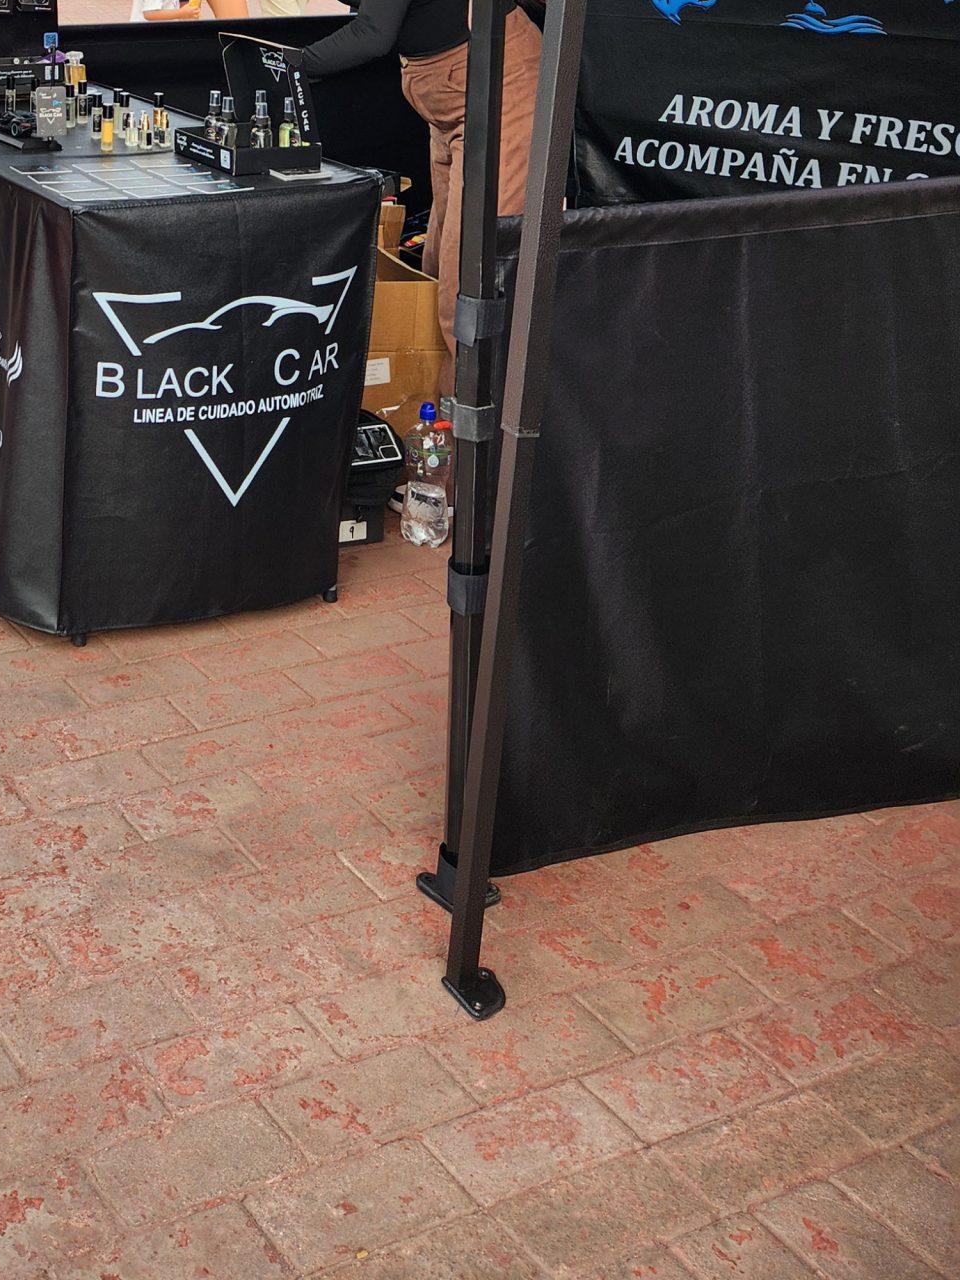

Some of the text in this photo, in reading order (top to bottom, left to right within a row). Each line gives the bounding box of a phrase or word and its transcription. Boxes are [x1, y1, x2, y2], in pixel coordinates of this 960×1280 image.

[293, 71, 310, 132] BLACK CAR
[658, 94, 960, 157] AROMA Y FRES
[613, 136, 823, 189] ACOMPAÑA
[95, 361, 235, 400] BLACK
[274, 342, 339, 387] CAR
[133, 384, 324, 424] LINEA DE CUIDADO AUTOMOTRIZ
